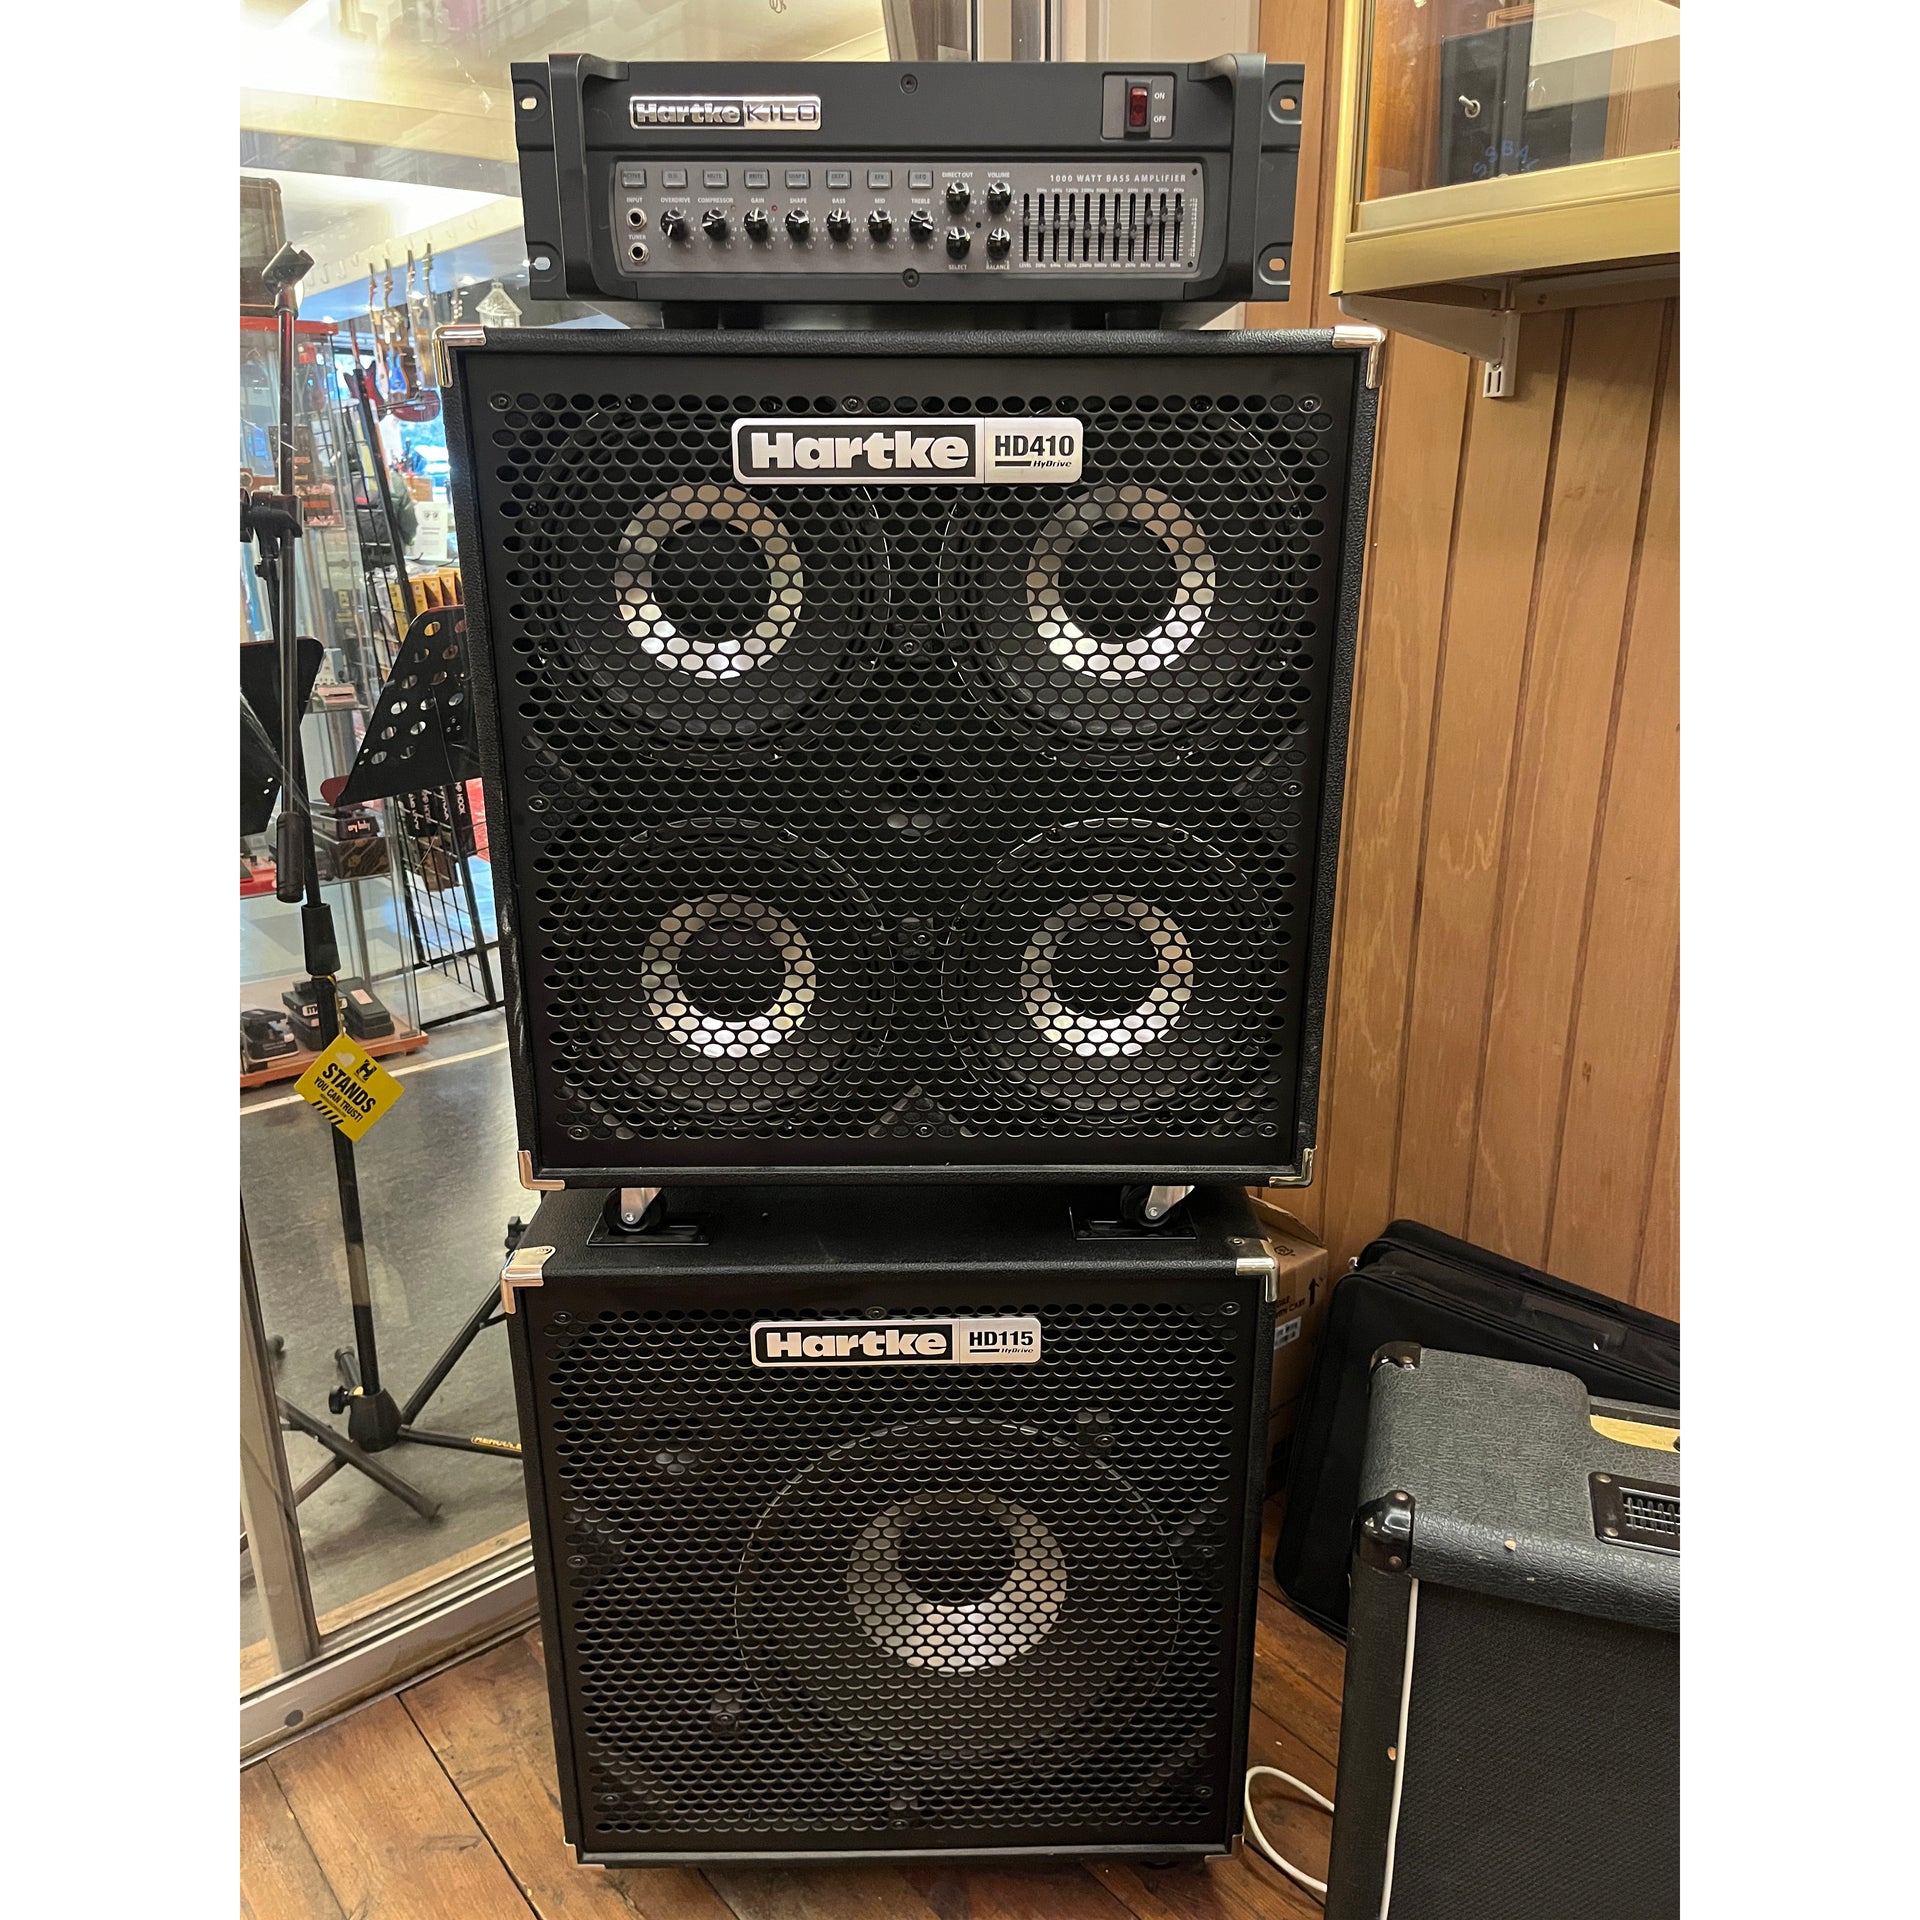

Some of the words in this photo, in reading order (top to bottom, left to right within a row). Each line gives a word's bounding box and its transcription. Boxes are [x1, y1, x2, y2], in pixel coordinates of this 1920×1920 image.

[1154, 92, 1165, 100] ON
[636, 102, 741, 123] Hartke
[747, 104, 817, 122] KILO
[1153, 115, 1167, 123] OFF
[1050, 174, 1073, 183] 1000
[1076, 174, 1102, 183] WATT
[1106, 174, 1130, 183] BASS
[1134, 174, 1186, 183] AMPLIFIER
[626, 196, 643, 204] INPUT
[660, 196, 691, 204] OVERDRIVE
[697, 196, 734, 204] COMPRESSOR
[750, 196, 765, 204] GAIN
[911, 197, 931, 205] TREBLE
[628, 233, 647, 241] TUNER
[948, 263, 967, 271] SELECT
[986, 263, 1010, 271] BALANCE
[750, 430, 970, 469] Hartke
[994, 435, 1075, 457] HD410
[1032, 459, 1072, 469] HyDrive
[322, 1062, 377, 1114] STANDS
[313, 1076, 329, 1092] YOU
[326, 1088, 341, 1104] CAN
[339, 1099, 364, 1123] TRUST!
[766, 1329, 948, 1358] Hartke
[969, 1330, 1034, 1347] HD115
